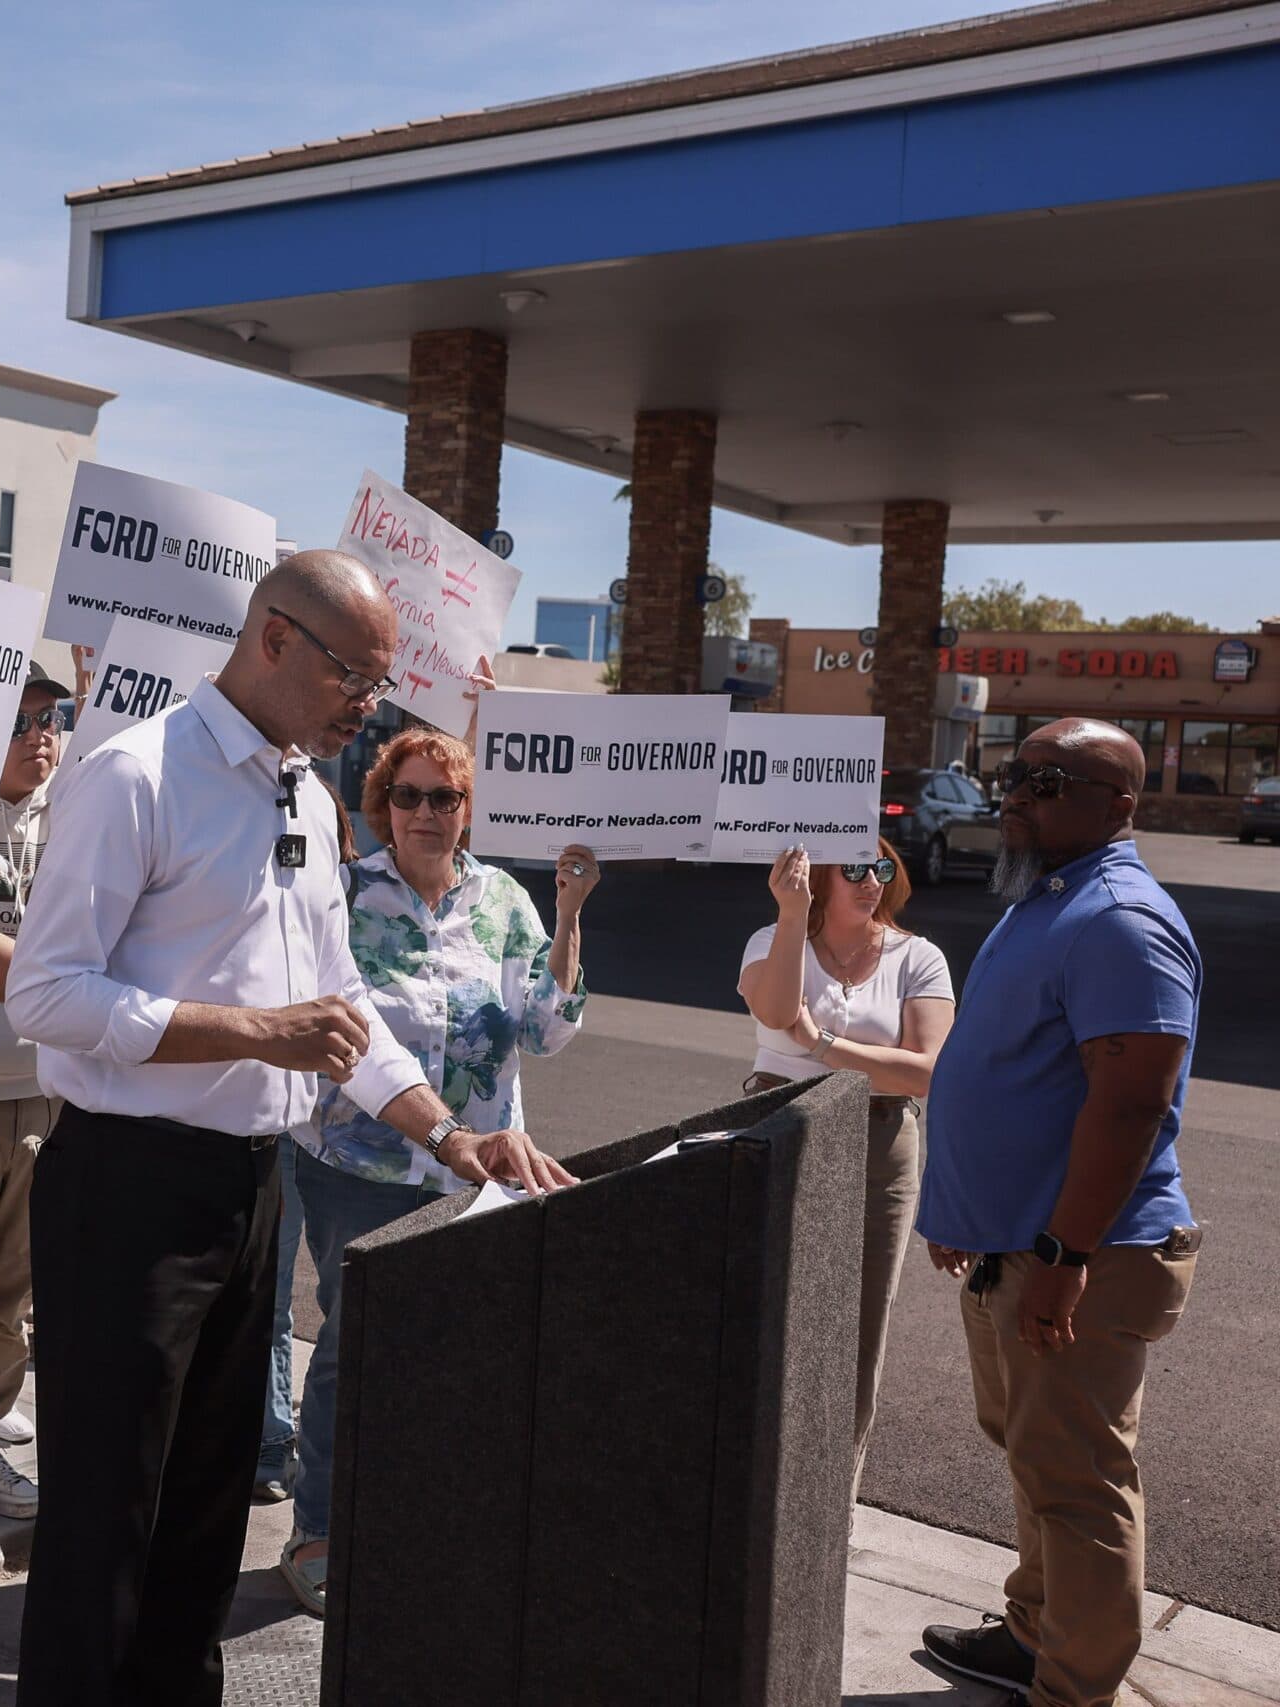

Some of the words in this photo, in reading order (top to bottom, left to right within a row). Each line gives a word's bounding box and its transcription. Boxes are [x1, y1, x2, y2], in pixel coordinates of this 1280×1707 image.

[72, 506, 159, 563] FORD
[161, 536, 181, 556] FOR
[351, 487, 441, 568] NEVADA
[494, 538, 506, 553] 11
[814, 646, 852, 673] Ice
[1058, 649, 1179, 680] SODA
[94, 664, 173, 719] FORD
[485, 731, 574, 775] FORD
[580, 745, 601, 763] FOR
[607, 741, 716, 771] GOVERNOR
[720, 749, 767, 785] RD
[771, 759, 789, 774] FOR
[793, 757, 876, 784] GOVERNOR
[714, 820, 791, 834] w.FordFor
